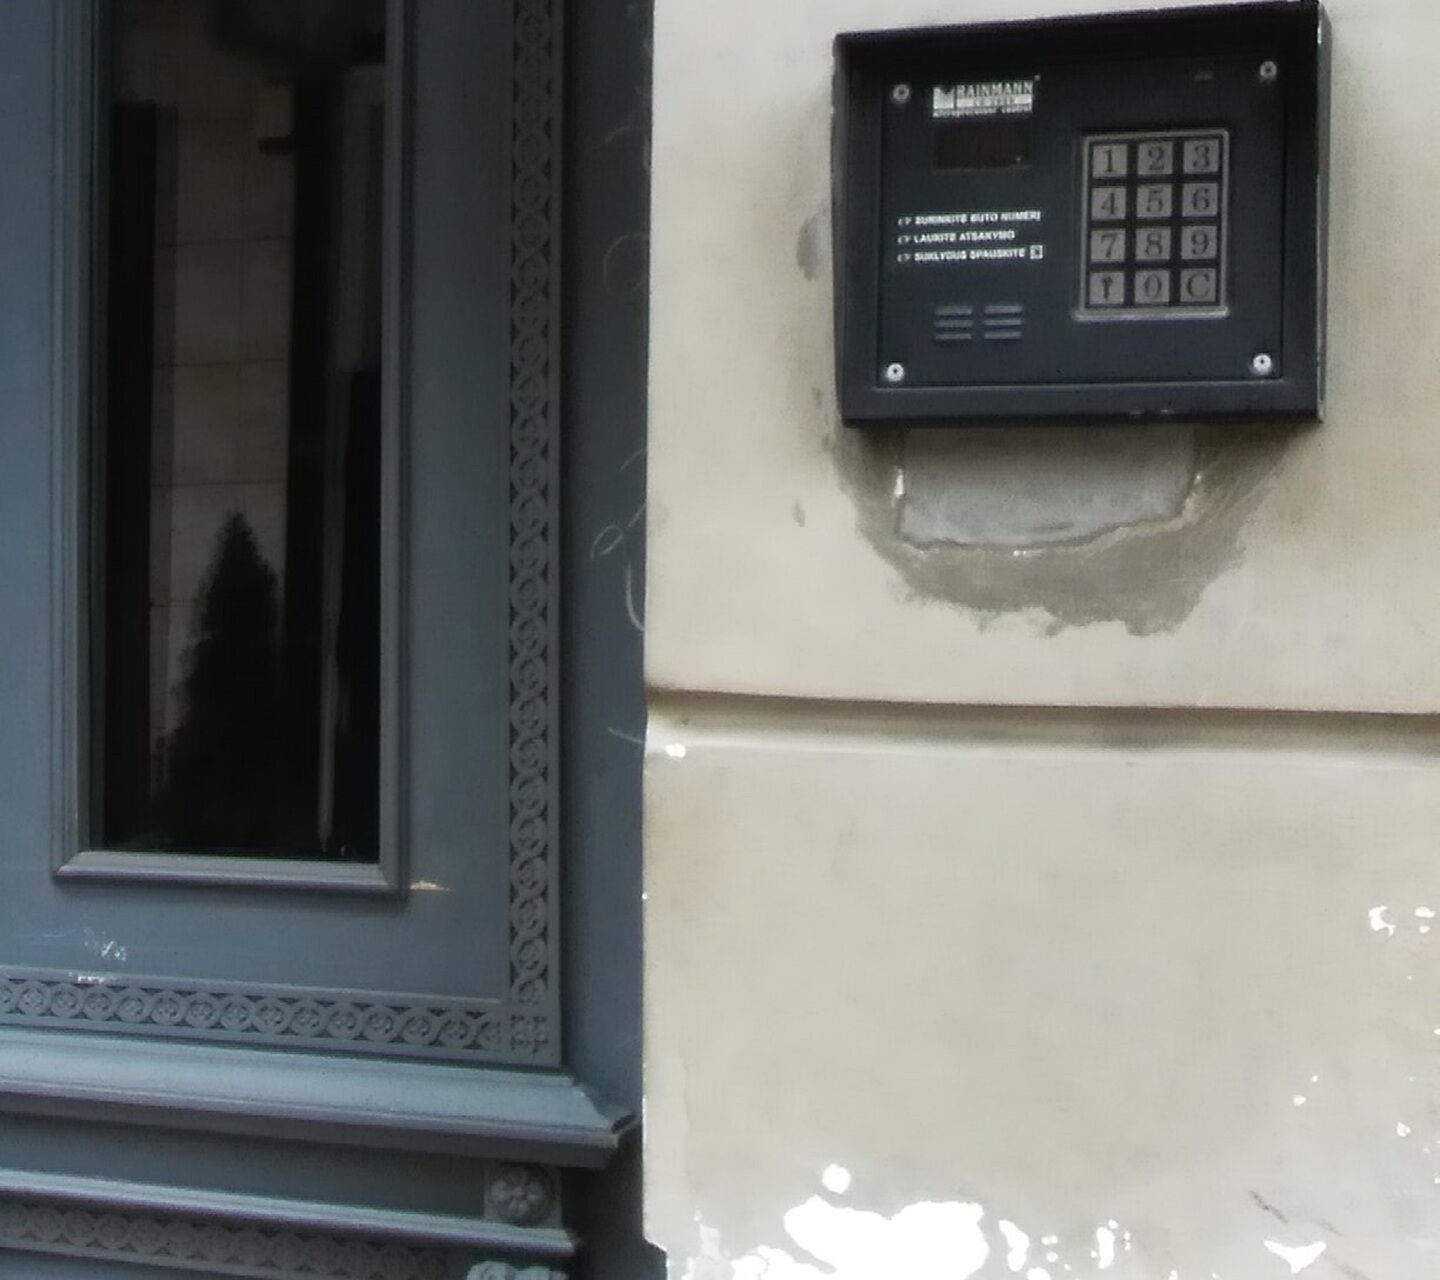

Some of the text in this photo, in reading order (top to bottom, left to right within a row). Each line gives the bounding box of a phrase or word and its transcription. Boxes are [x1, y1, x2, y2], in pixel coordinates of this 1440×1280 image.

[1104, 144, 1210, 173] 1 2 3
[1101, 187, 1210, 215] 4 5 6
[970, 212, 998, 223] BUTO
[1101, 230, 1209, 258] 7 8 9
[1144, 273, 1210, 299] 0 C
